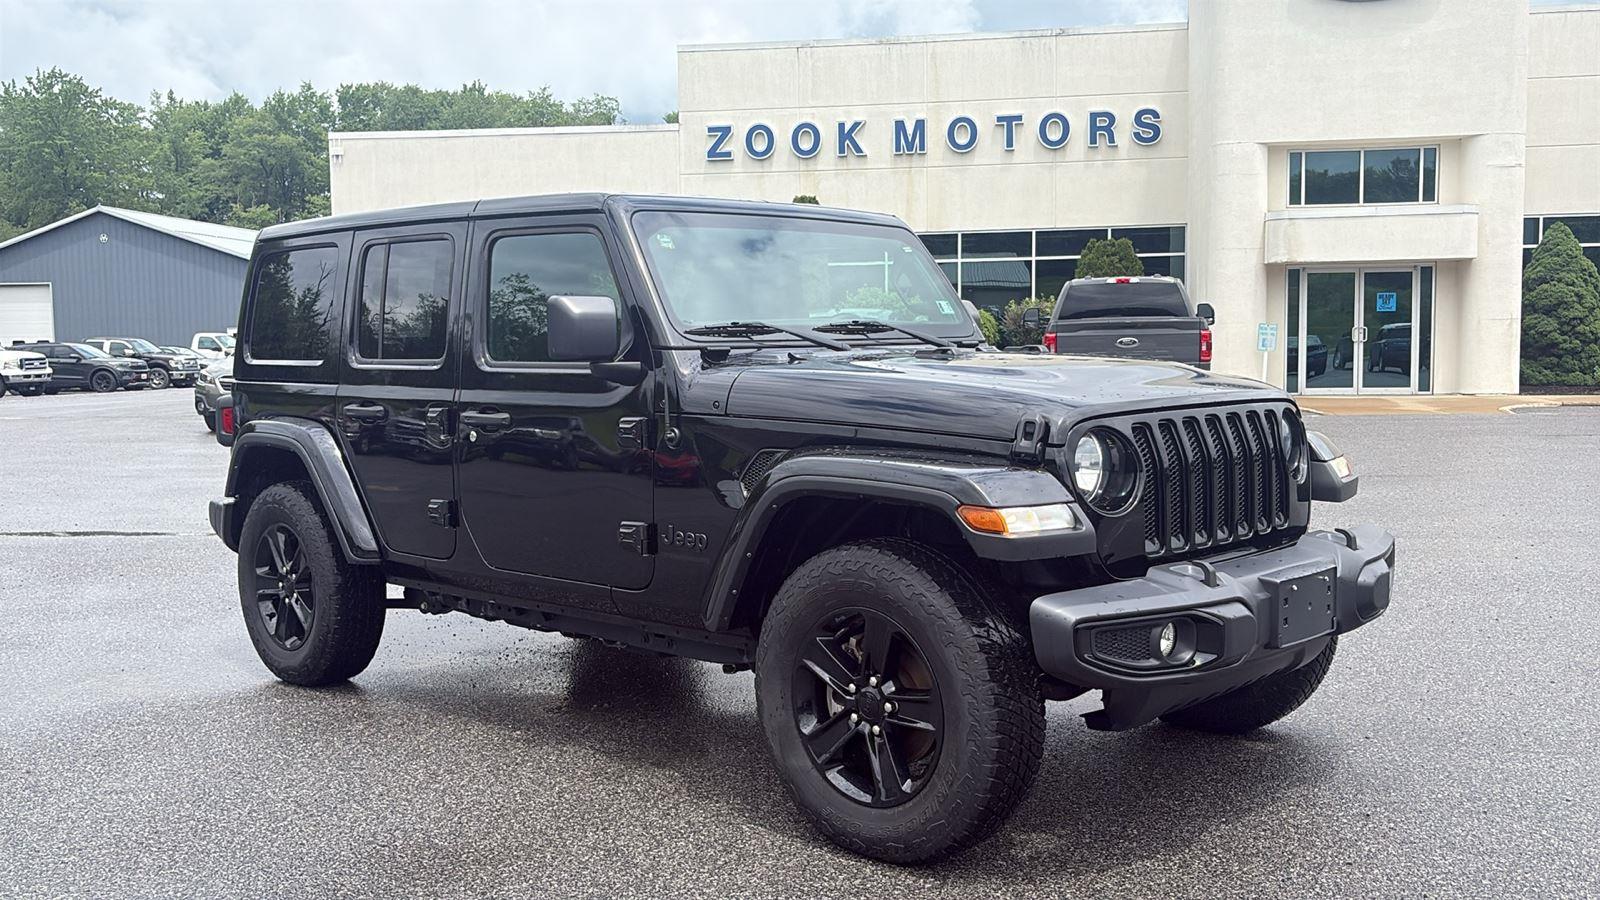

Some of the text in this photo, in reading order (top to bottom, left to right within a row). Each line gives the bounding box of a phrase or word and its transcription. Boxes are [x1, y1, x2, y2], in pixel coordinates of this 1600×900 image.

[706, 107, 1163, 160] ZOOK MOTORS
[660, 524, 708, 552] Jeep
